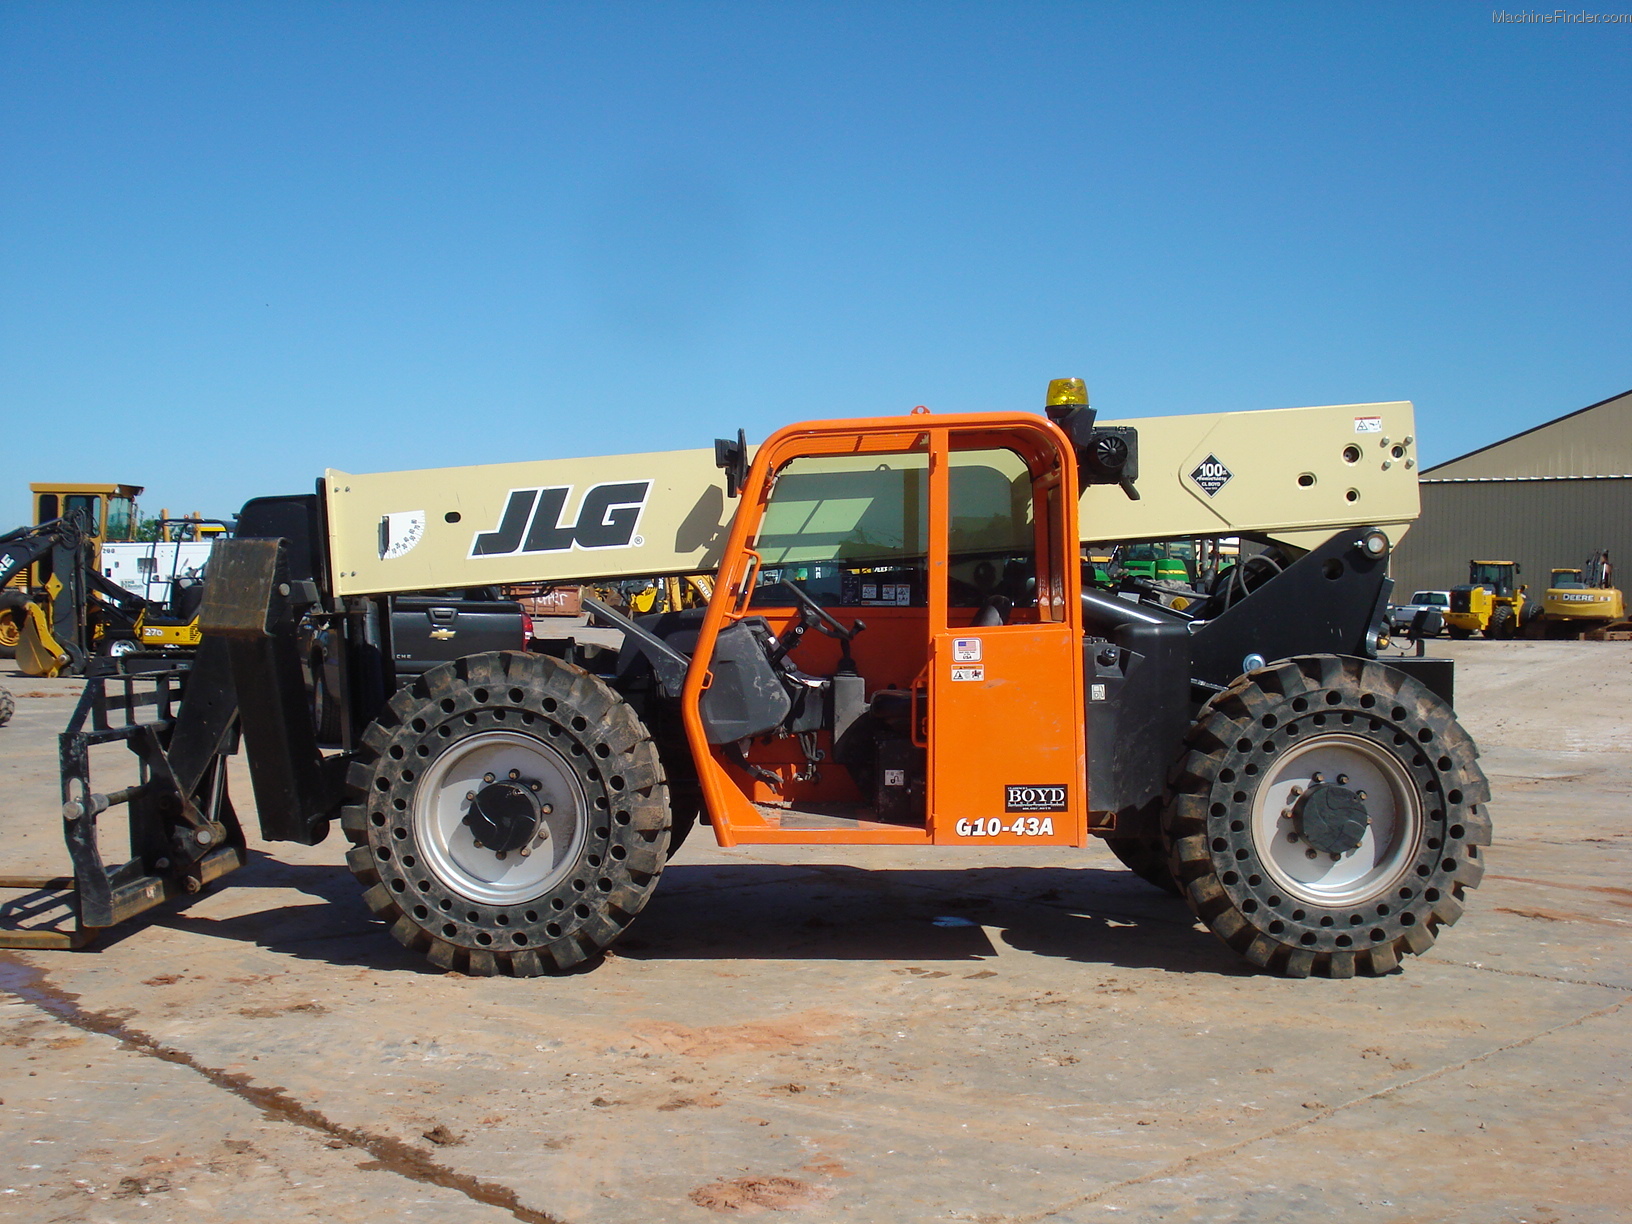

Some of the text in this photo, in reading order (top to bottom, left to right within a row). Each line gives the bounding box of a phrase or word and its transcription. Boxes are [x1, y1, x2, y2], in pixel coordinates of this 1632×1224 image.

[466, 479, 654, 559] JLG
[1562, 593, 1595, 602] DEERE
[1008, 789, 1065, 803] BOYD
[955, 817, 1054, 837] G10-43A
